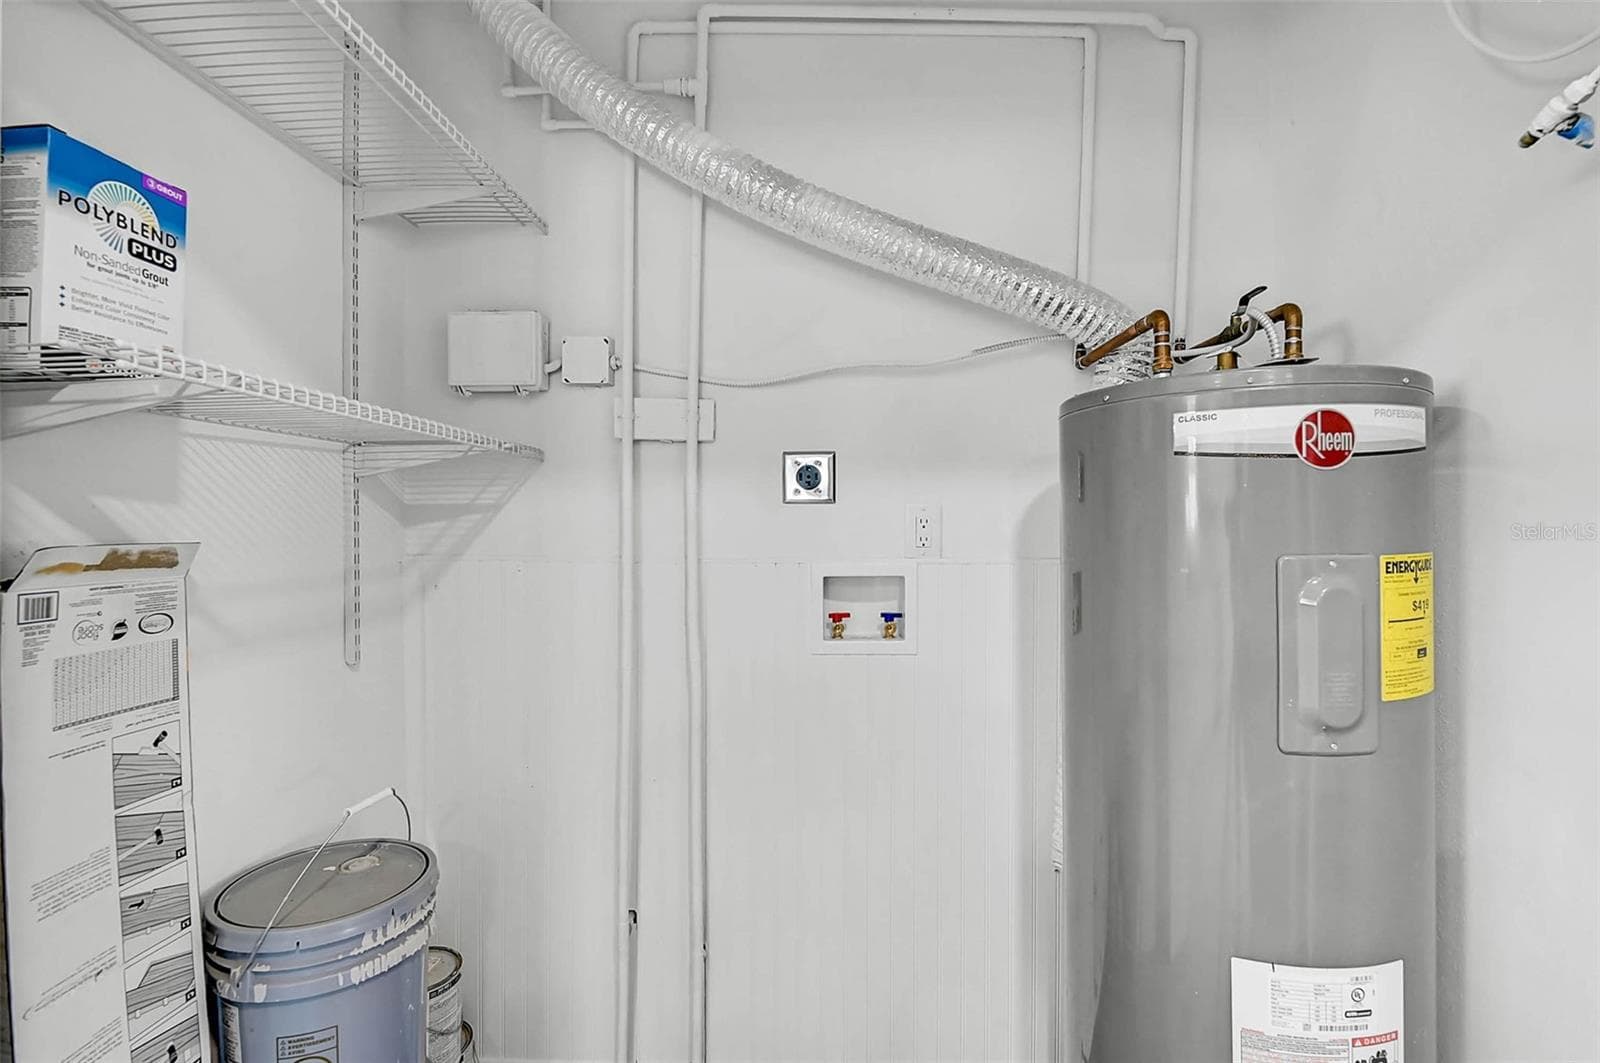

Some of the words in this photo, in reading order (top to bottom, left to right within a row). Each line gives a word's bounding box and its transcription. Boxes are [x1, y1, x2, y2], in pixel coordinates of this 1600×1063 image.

[157, 183, 183, 201] GROUT
[58, 189, 177, 249] POLYBLEND
[74, 244, 141, 276] Non-Sanded
[142, 268, 169, 287] Grout
[131, 241, 174, 268] PLUS
[1178, 413, 1217, 424] CLASSIC
[1374, 407, 1425, 421] PROFESSIONAL
[1302, 411, 1353, 459] Rheem
[1364, 1033, 1398, 1044] DANGER
